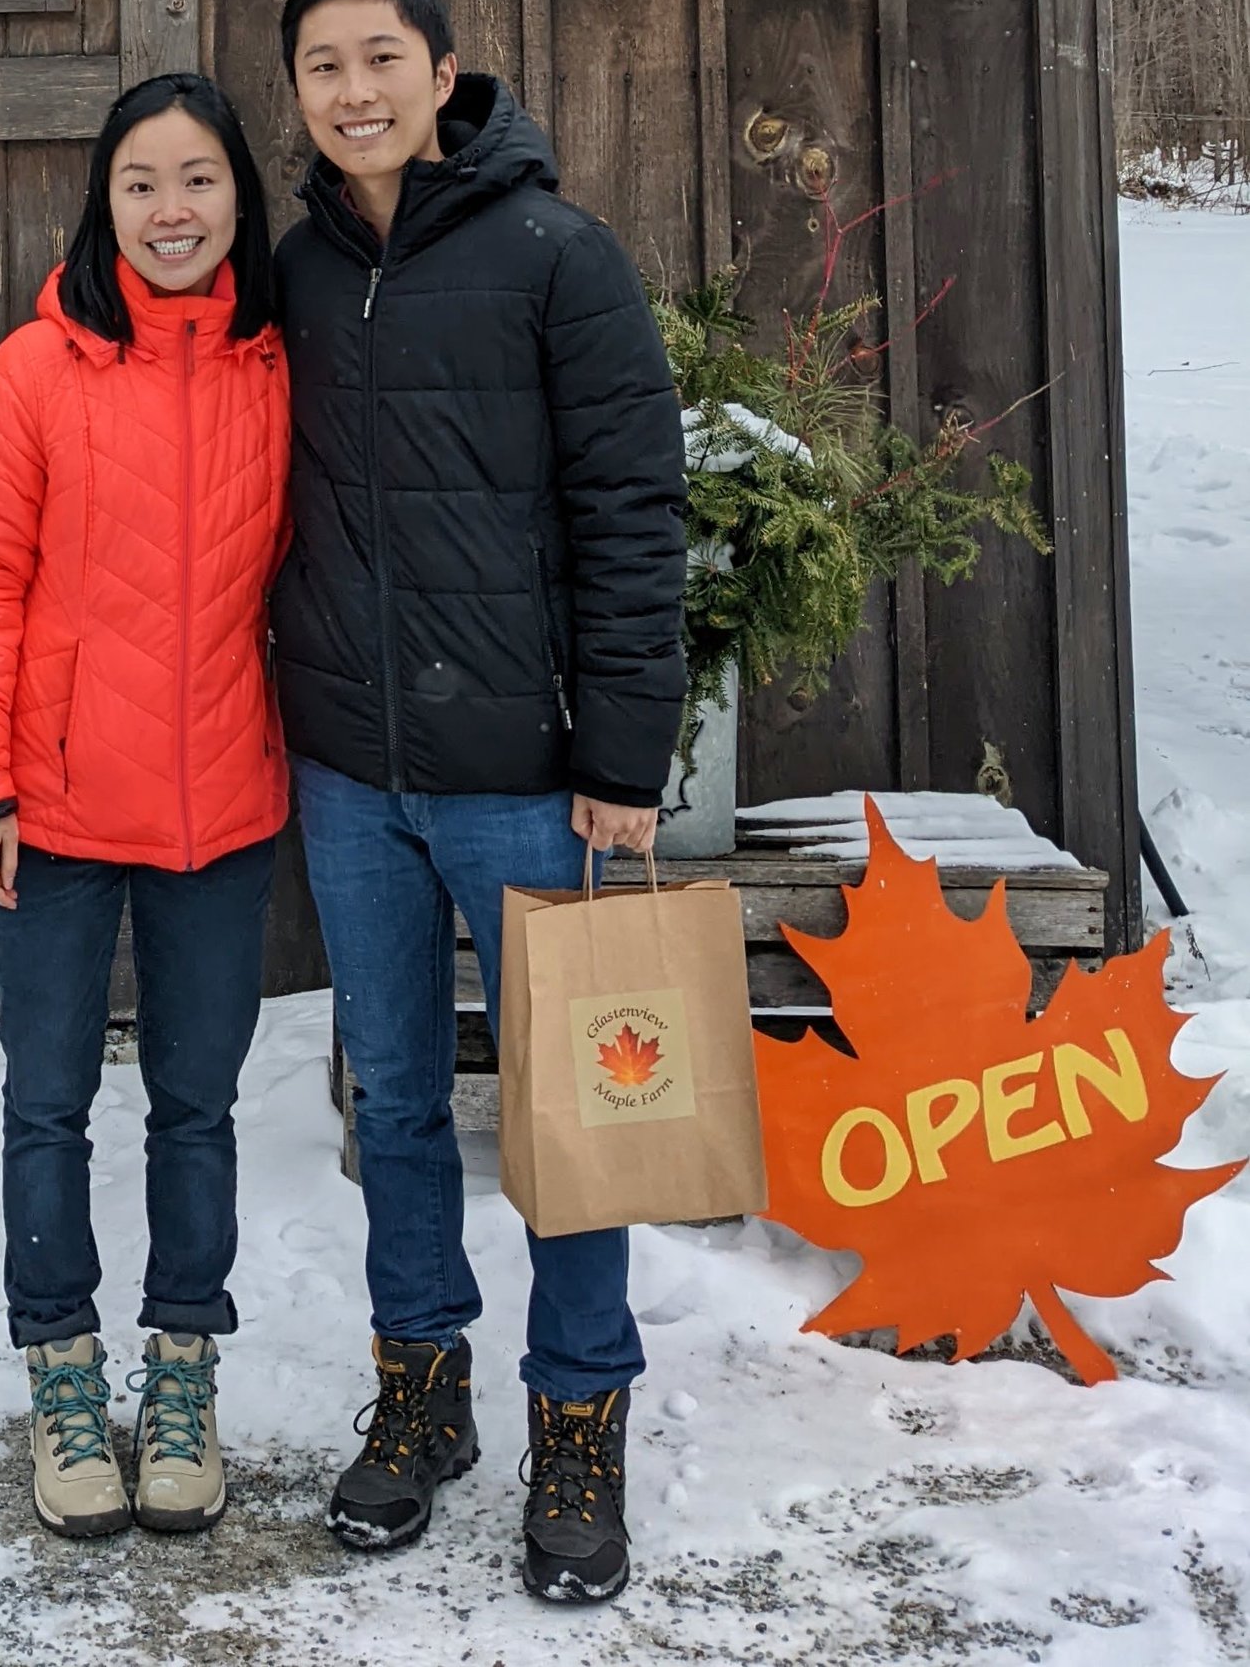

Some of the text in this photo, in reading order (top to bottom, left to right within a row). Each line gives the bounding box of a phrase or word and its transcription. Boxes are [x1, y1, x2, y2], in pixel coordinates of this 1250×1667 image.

[586, 1007, 669, 1039] Glastenview
[593, 1077, 674, 1110] Maple Farm
[821, 1028, 1149, 1207] OPEN
